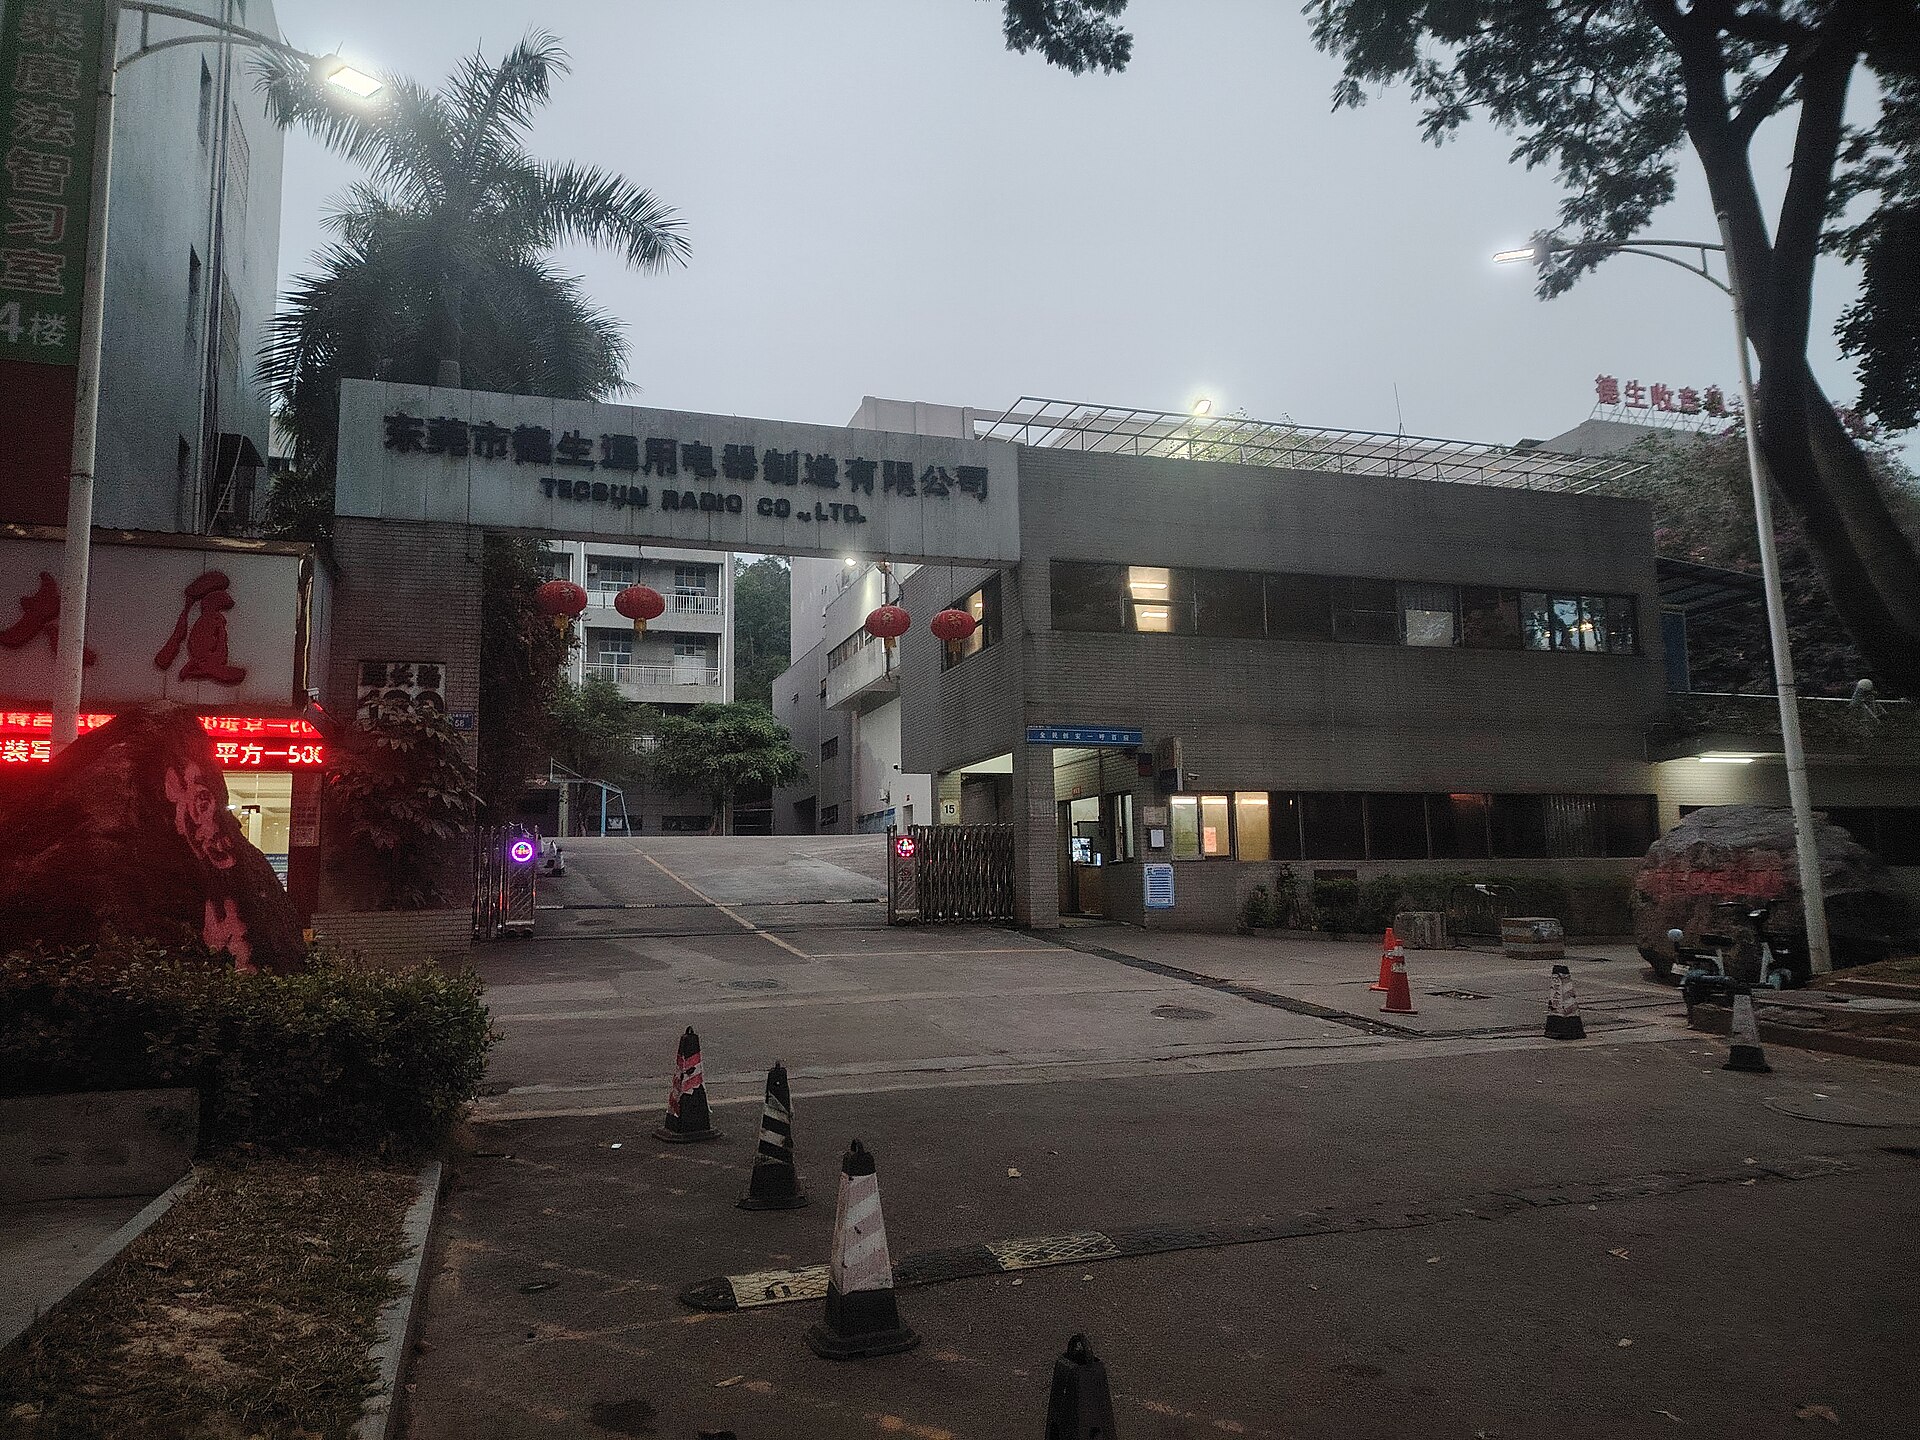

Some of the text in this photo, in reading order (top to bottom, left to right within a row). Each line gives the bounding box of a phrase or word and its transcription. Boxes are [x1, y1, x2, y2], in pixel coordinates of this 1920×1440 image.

[539, 477, 650, 509] TECSUN
[661, 488, 743, 514] RADIO
[944, 803, 956, 815] 15
